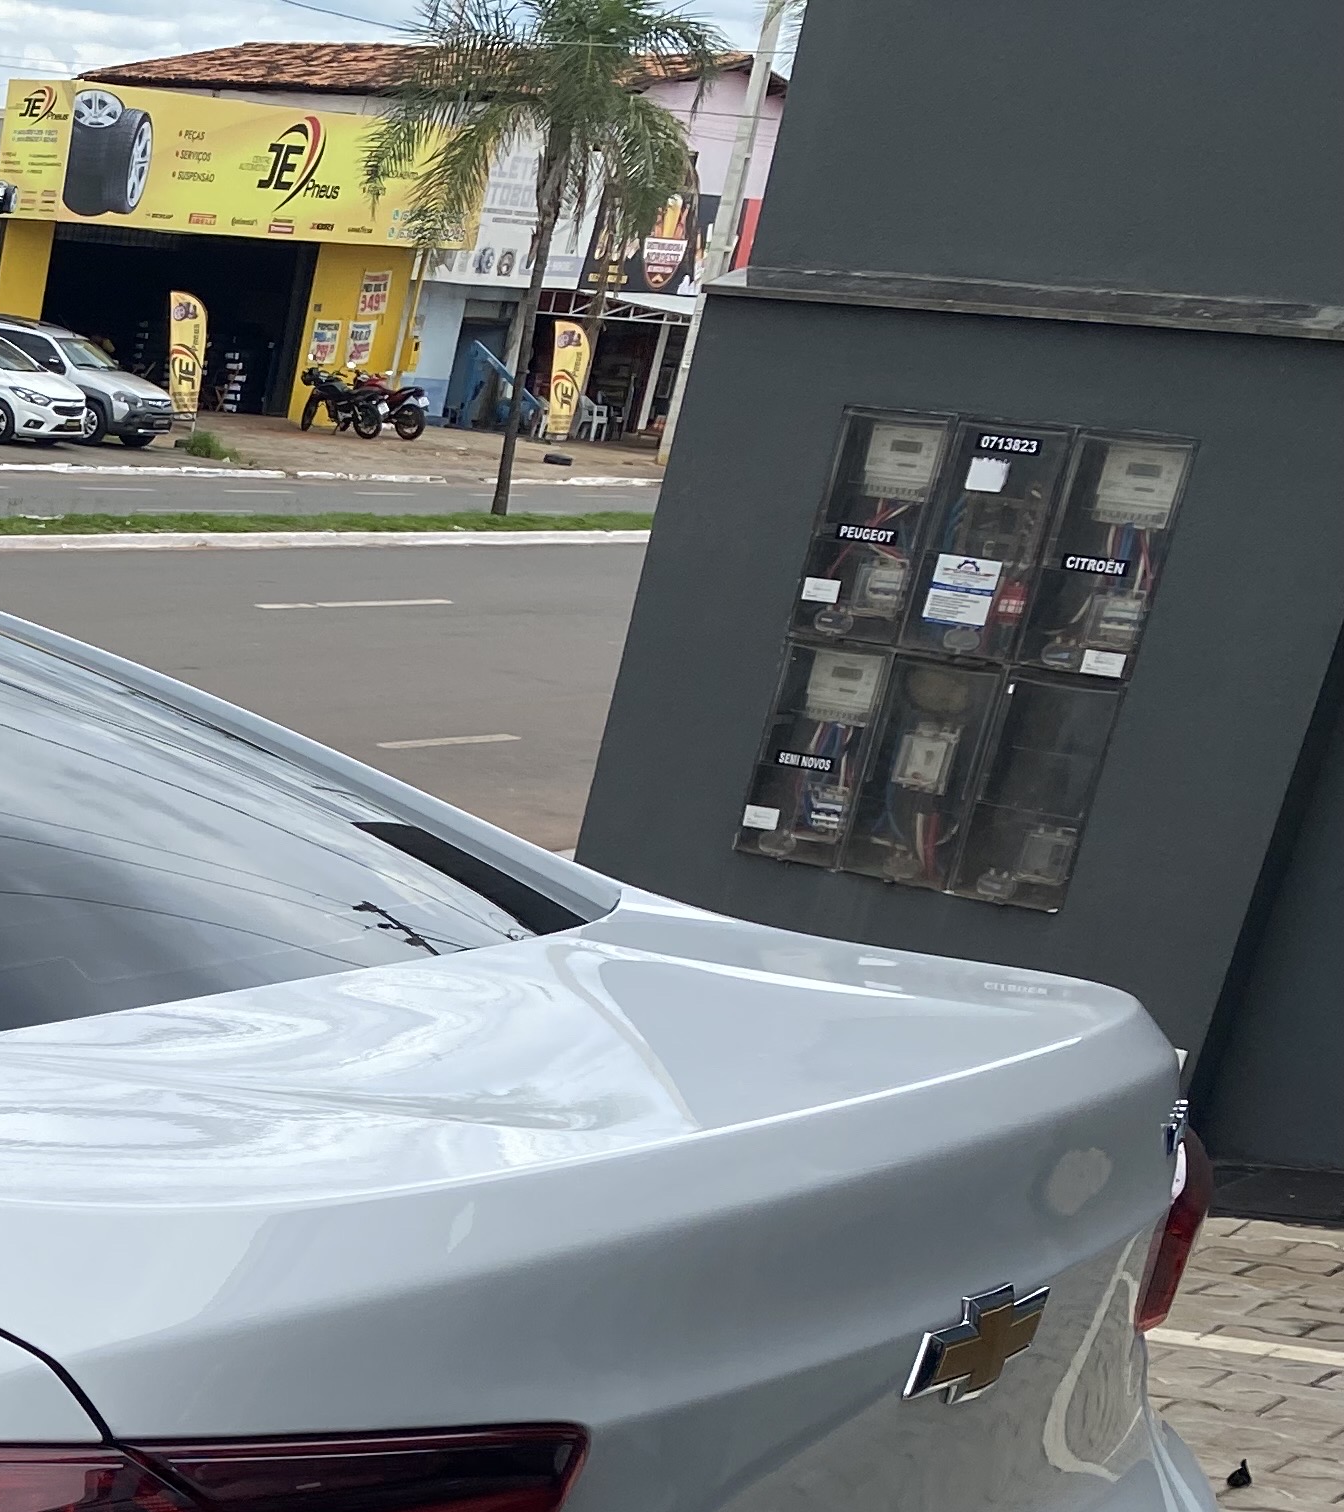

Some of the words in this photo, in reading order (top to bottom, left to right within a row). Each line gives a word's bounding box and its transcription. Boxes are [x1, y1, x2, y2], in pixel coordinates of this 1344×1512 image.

[19, 98, 45, 117] JE
[184, 130, 205, 142] PEÇAS
[180, 150, 211, 163] SERVIÇOS
[177, 170, 215, 183] SUSPENSÃO
[256, 143, 305, 191] JE
[303, 179, 340, 200] Pneus
[981, 435, 1038, 453] 0713823
[839, 525, 894, 543] PEUGEOT
[1066, 555, 1125, 575] CITROËN
[778, 752, 800, 766] SEMI
[801, 756, 832, 771] NOVOS
